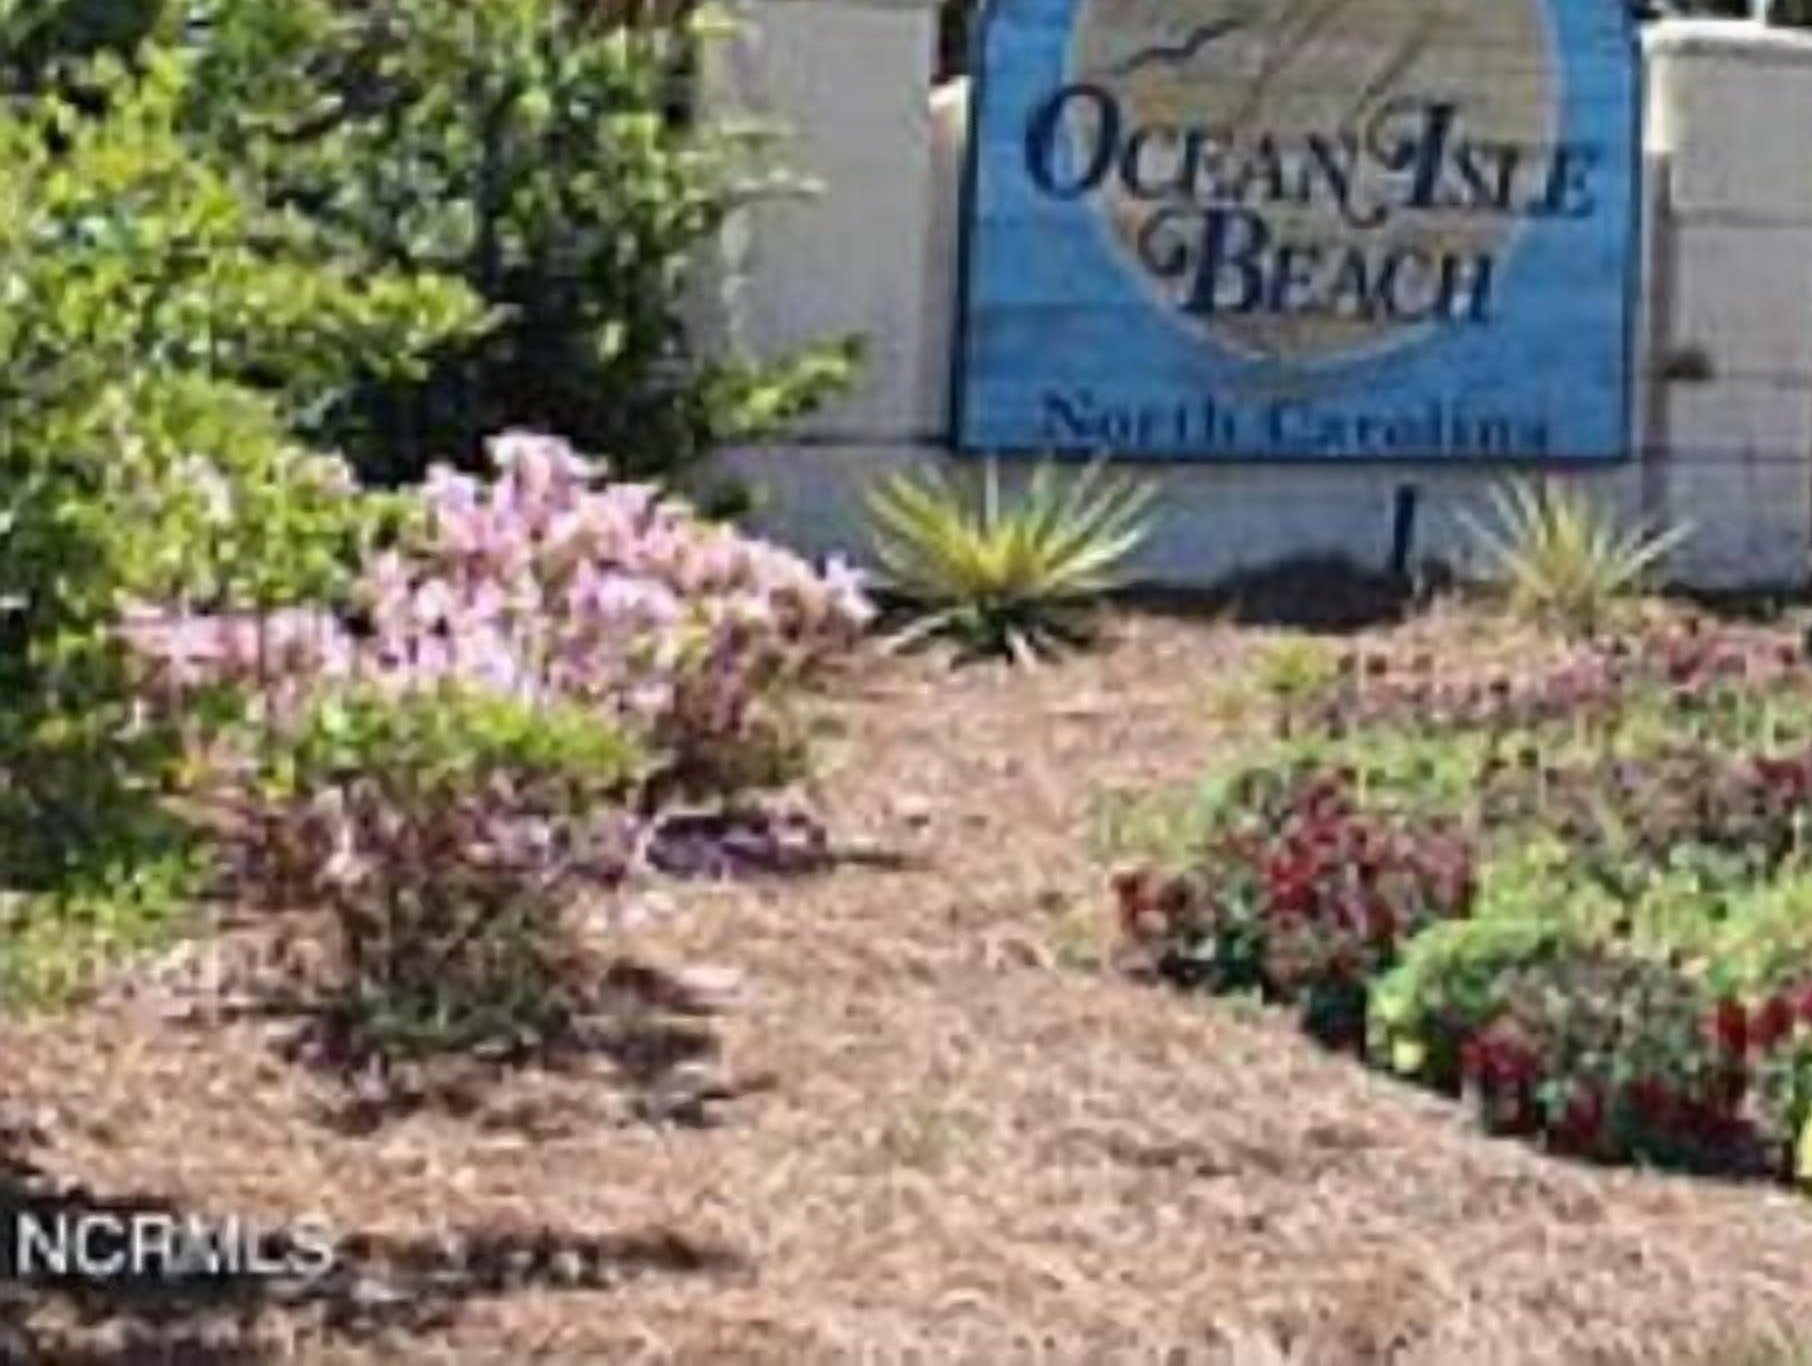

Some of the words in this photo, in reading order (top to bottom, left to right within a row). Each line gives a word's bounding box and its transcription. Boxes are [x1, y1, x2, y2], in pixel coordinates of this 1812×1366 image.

[1357, 101, 1599, 218] ISLE
[1137, 206, 1493, 324] BEACH
[1043, 390, 1239, 444] North
